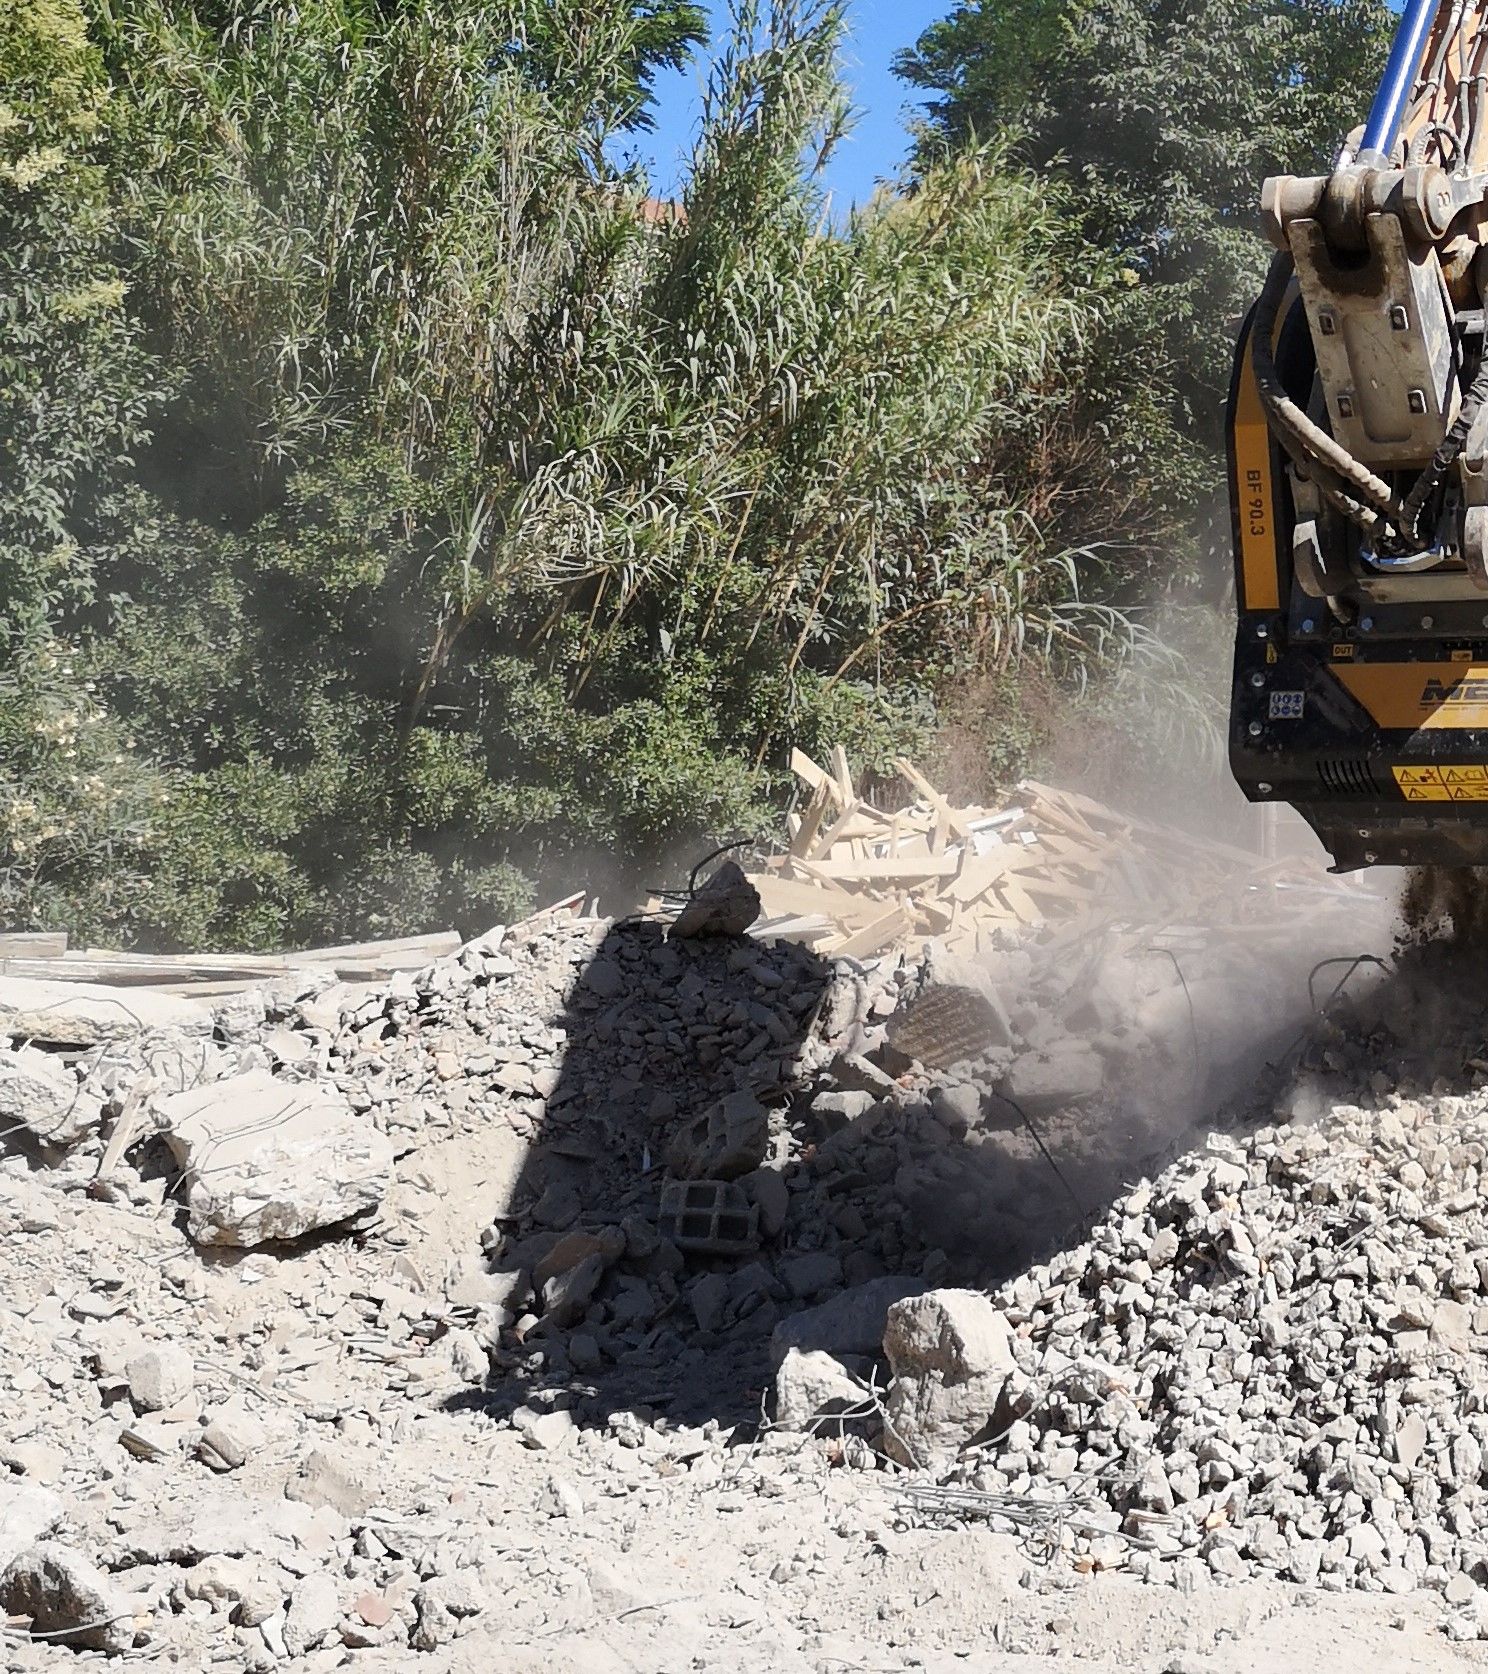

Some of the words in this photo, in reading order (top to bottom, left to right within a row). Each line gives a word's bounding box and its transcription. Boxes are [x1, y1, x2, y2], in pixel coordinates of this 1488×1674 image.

[1247, 470, 1262, 493] BF
[1248, 498, 1266, 536] 90.3
[1334, 646, 1352, 655] OUT
